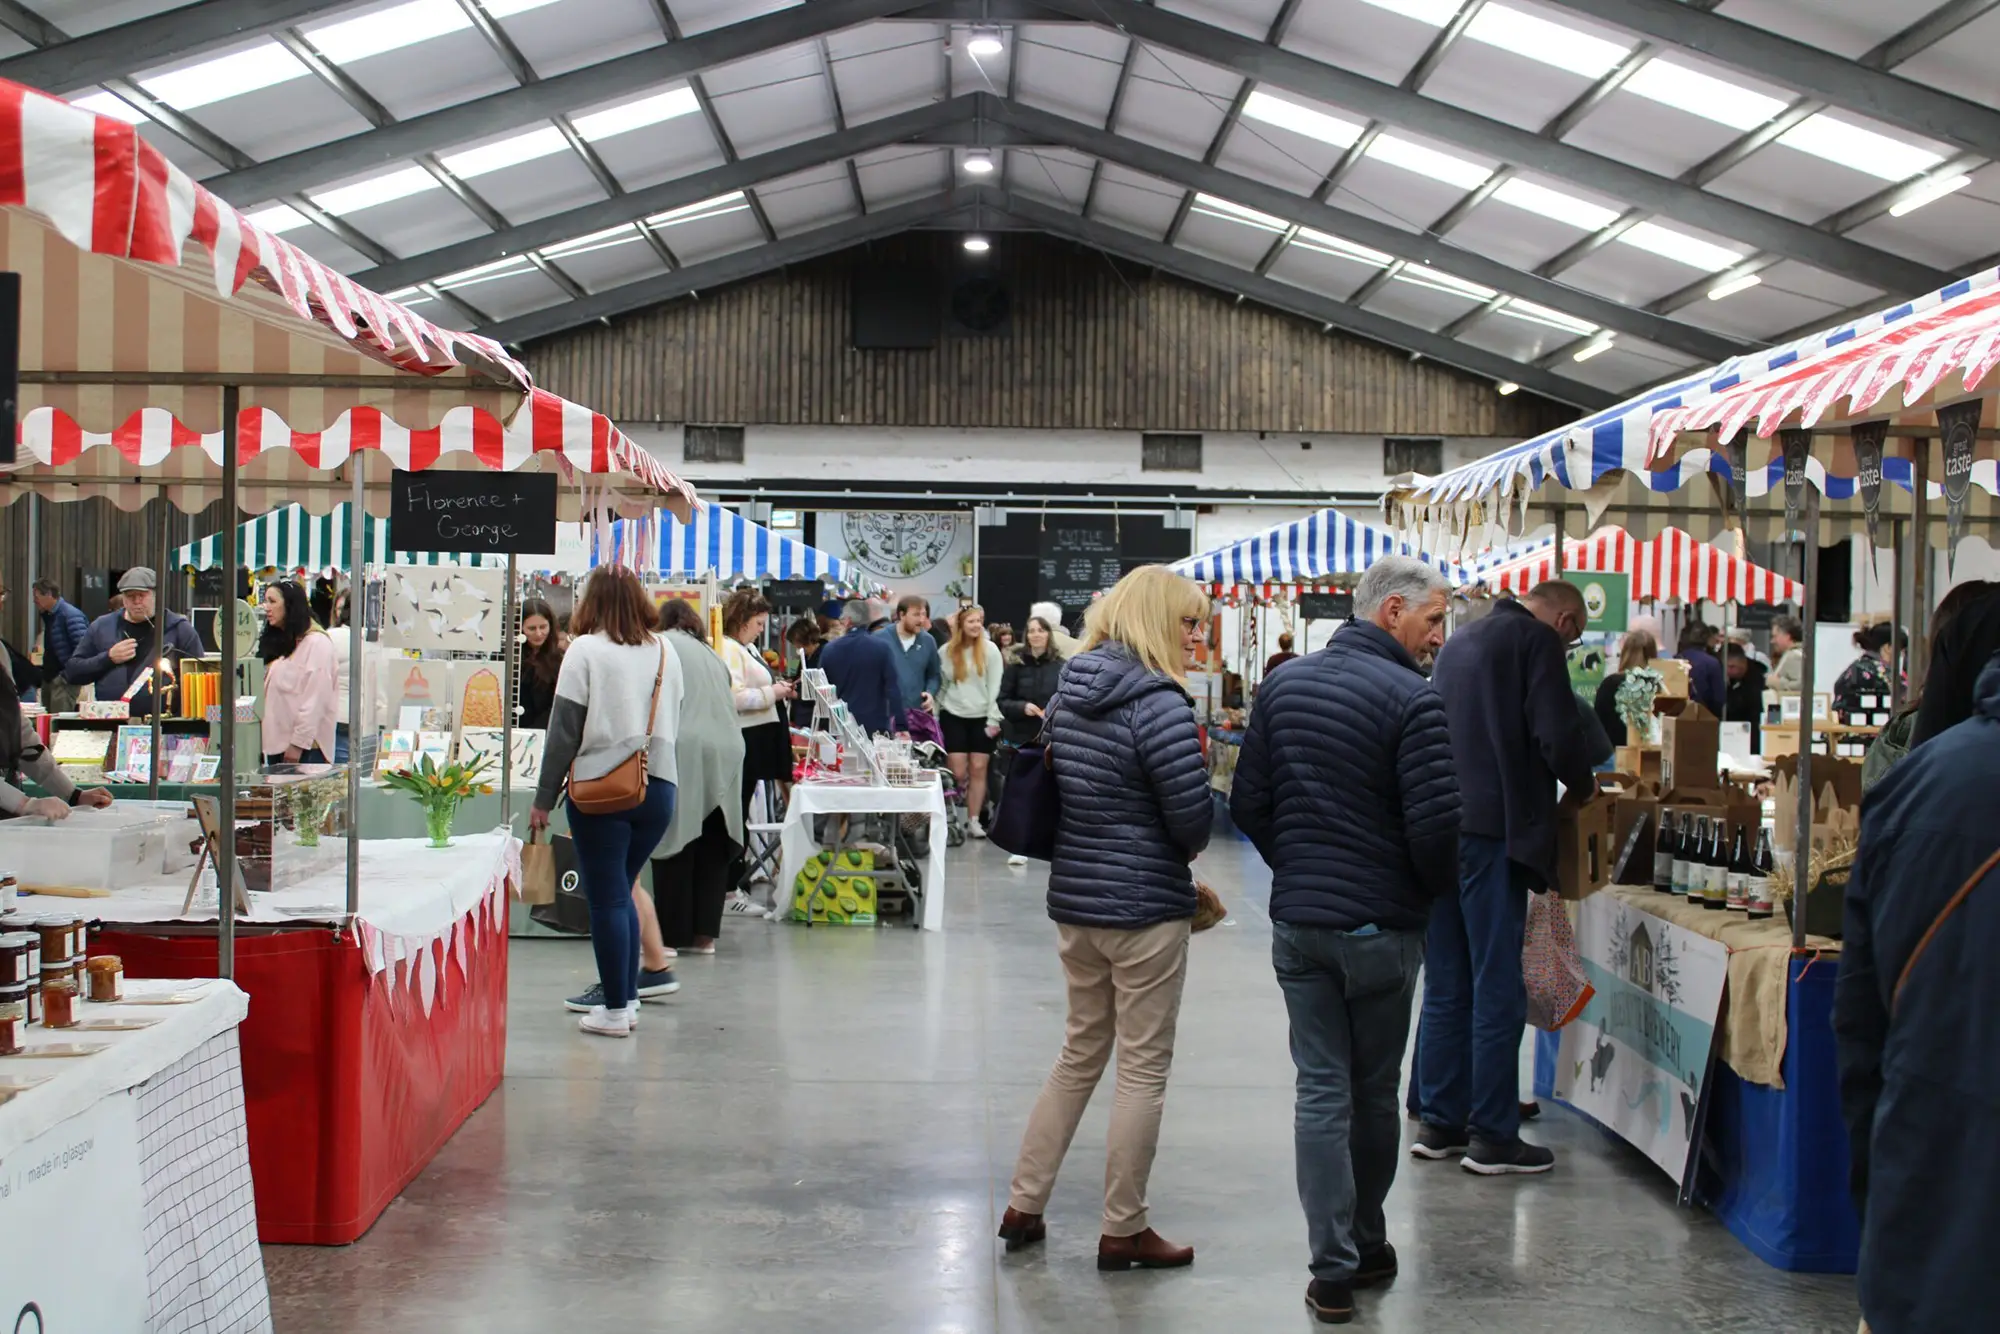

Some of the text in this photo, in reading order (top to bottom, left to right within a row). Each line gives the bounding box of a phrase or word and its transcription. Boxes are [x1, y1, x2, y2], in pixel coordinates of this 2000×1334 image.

[1946, 453, 1971, 476] taste
[407, 483, 526, 512] Florence +
[436, 514, 518, 545] George
[1632, 943, 1651, 985] AB
[28, 1154, 52, 1184] made
[53, 1151, 61, 1170] in
[62, 1133, 95, 1170] glasgow
